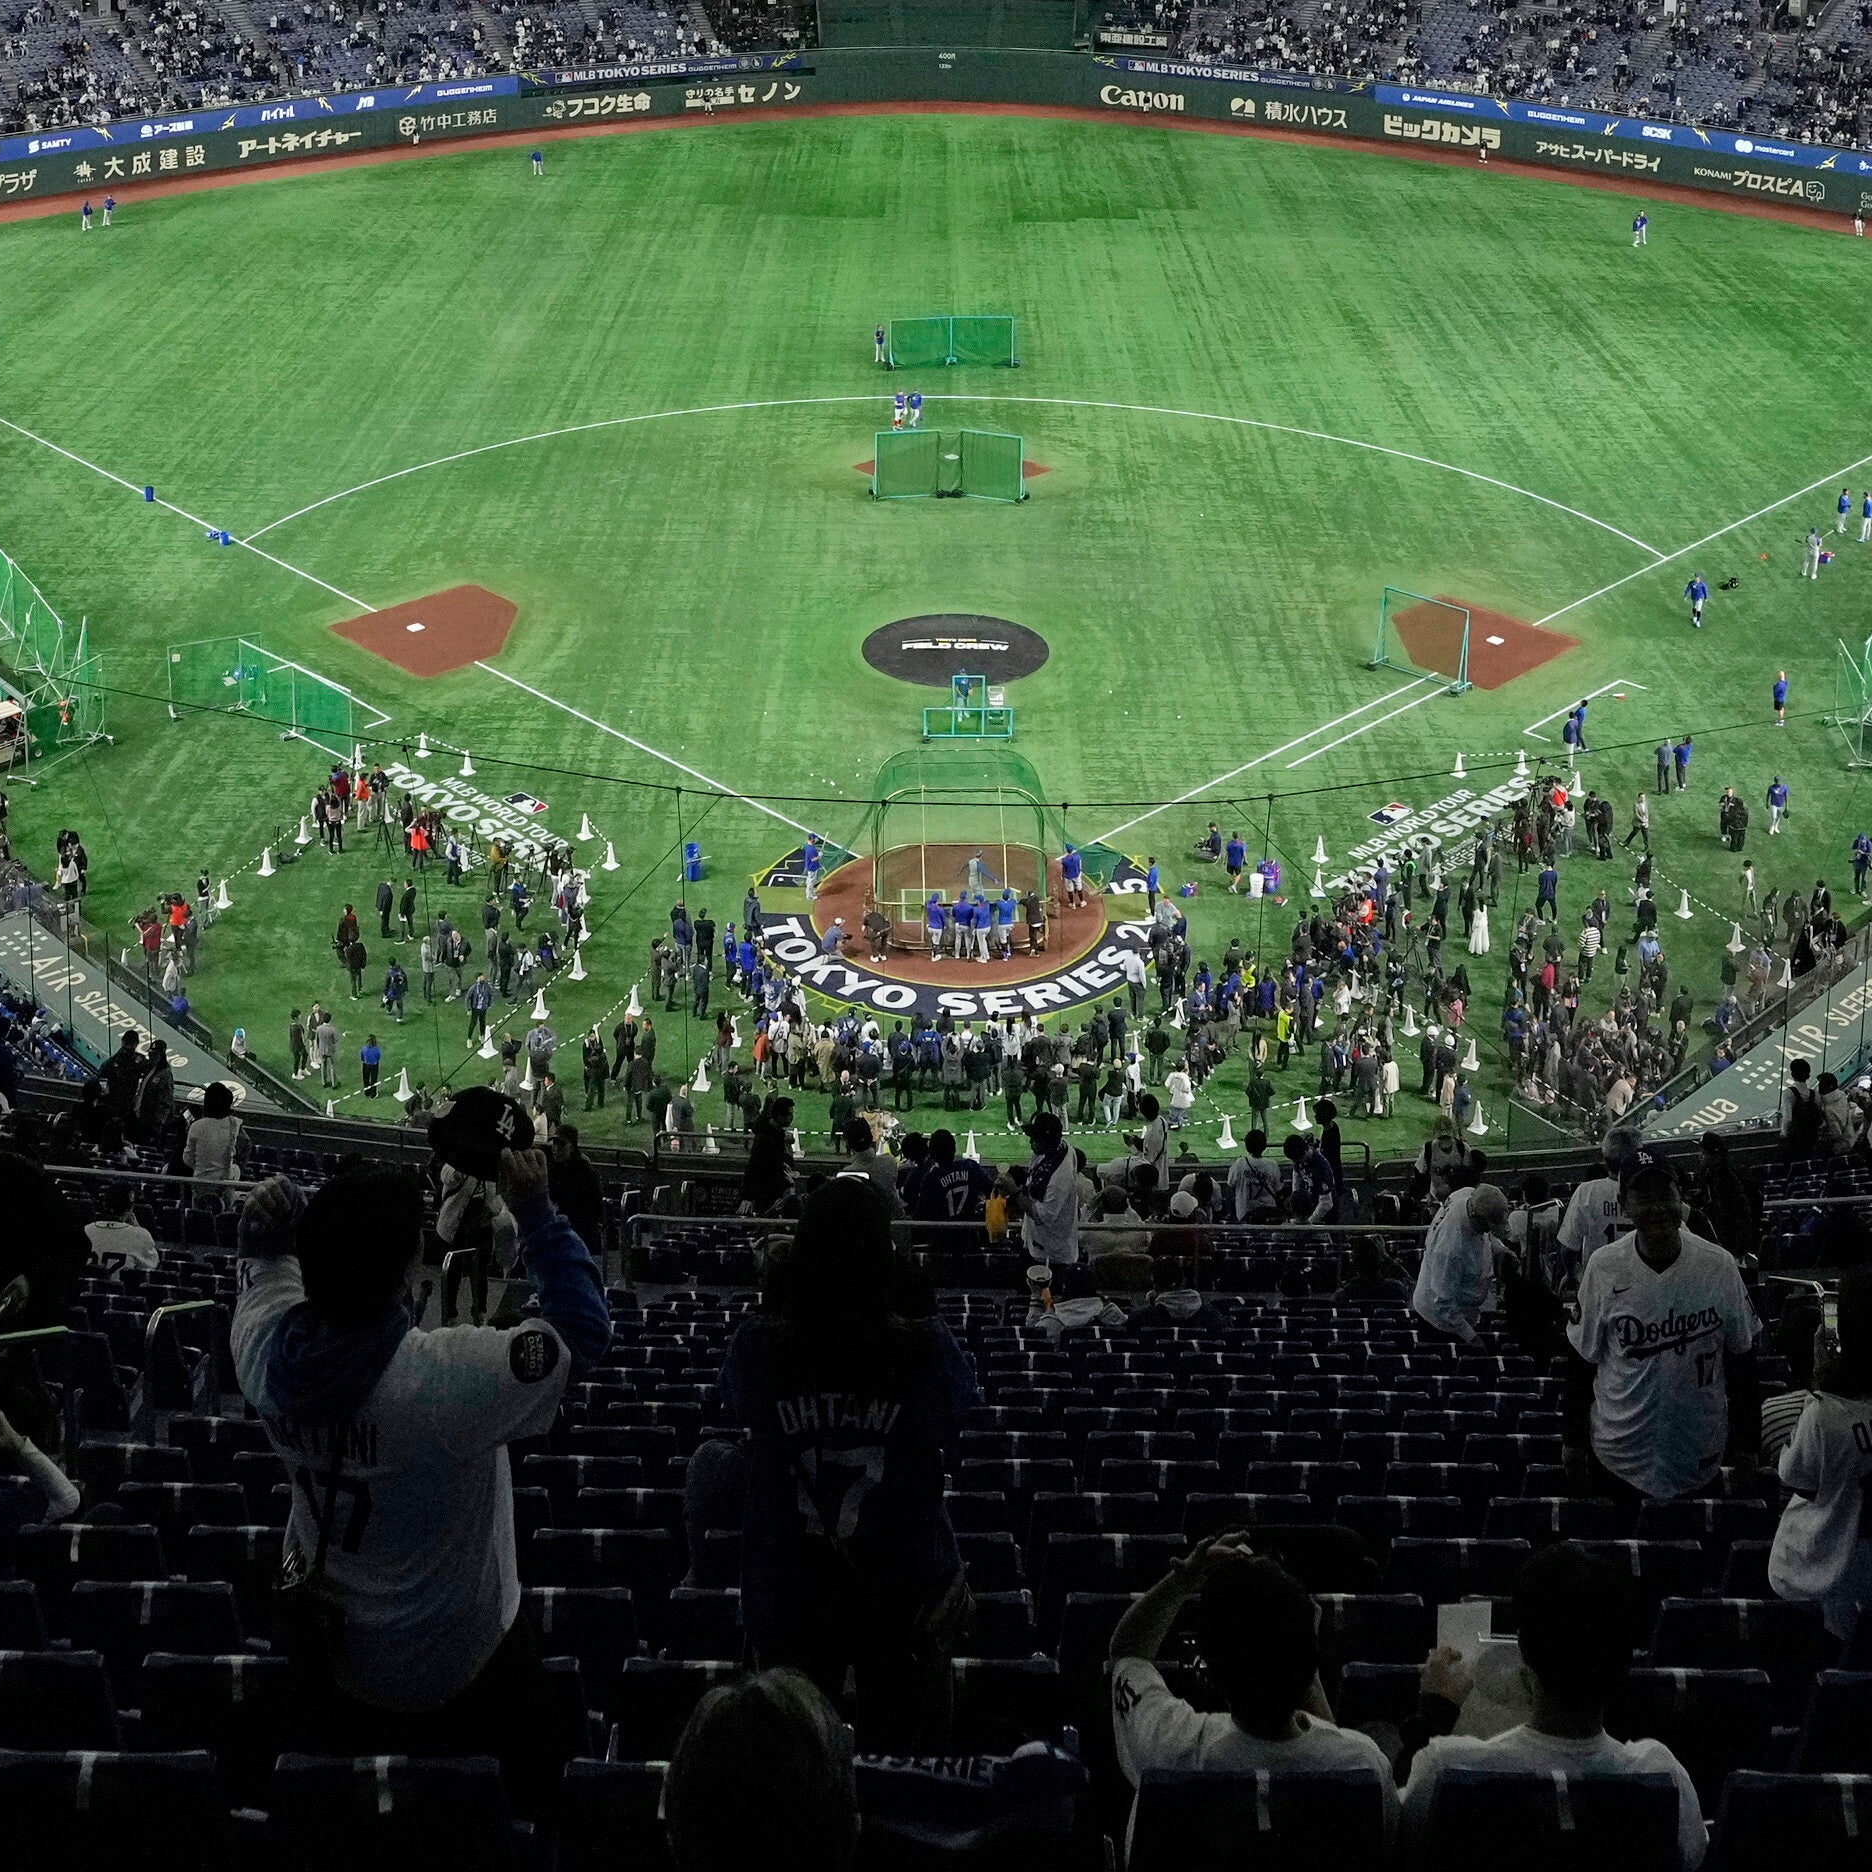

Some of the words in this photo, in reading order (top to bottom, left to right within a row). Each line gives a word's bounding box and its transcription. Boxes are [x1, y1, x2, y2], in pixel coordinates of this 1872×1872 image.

[573, 70, 596, 82] MLB
[598, 65, 641, 80] TOKYO
[641, 63, 687, 77] SERIES
[1146, 61, 1169, 74] MLB
[1169, 63, 1214, 78] TOKYO
[1214, 68, 1259, 83] SERIES
[567, 92, 651, 118] フコク生命
[738, 82, 802, 103] セノン
[1100, 85, 1185, 112] Canon
[1412, 95, 1436, 105] JAPAN
[1437, 98, 1475, 109] AIRLINES
[420, 109, 497, 132] 竹中工務店
[1264, 101, 1348, 129] 積水ハウス
[1527, 110, 1585, 125] GUGGENHEIM
[41, 138, 72, 150] SAMTY
[239, 129, 361, 158] アートネイチャー
[1384, 114, 1501, 150] ビックカメラ
[1641, 126, 1672, 140] SCSK
[104, 145, 206, 179] 大成建設
[1536, 141, 1661, 173] アサヒスーパードライ
[1755, 144, 1795, 157] mastercard
[1694, 167, 1732, 181] KONAMI
[1733, 172, 1804, 197] プロスピA
[901, 640, 955, 652] FIELD
[958, 640, 1010, 652] CREW
[379, 761, 480, 822] TOKYO
[440, 776, 476, 798] MLB
[473, 792, 528, 827] WORLD
[523, 824, 569, 851] TOUR
[1430, 776, 1535, 838] SERIES
[1348, 837, 1385, 860] MLB
[1380, 809, 1439, 847] WORLD
[1431, 789, 1477, 813] TOUR
[763, 916, 917, 1009] TOKYO
[937, 944, 1136, 1018] SERIES
[940, 1170, 969, 1188] OHTANI
[946, 1185, 969, 1217] 17
[1616, 1306, 1723, 1359] Dodgers
[1694, 1350, 1718, 1389] 17
[776, 1392, 902, 1435] OHTANI
[788, 1446, 886, 1539] 17
